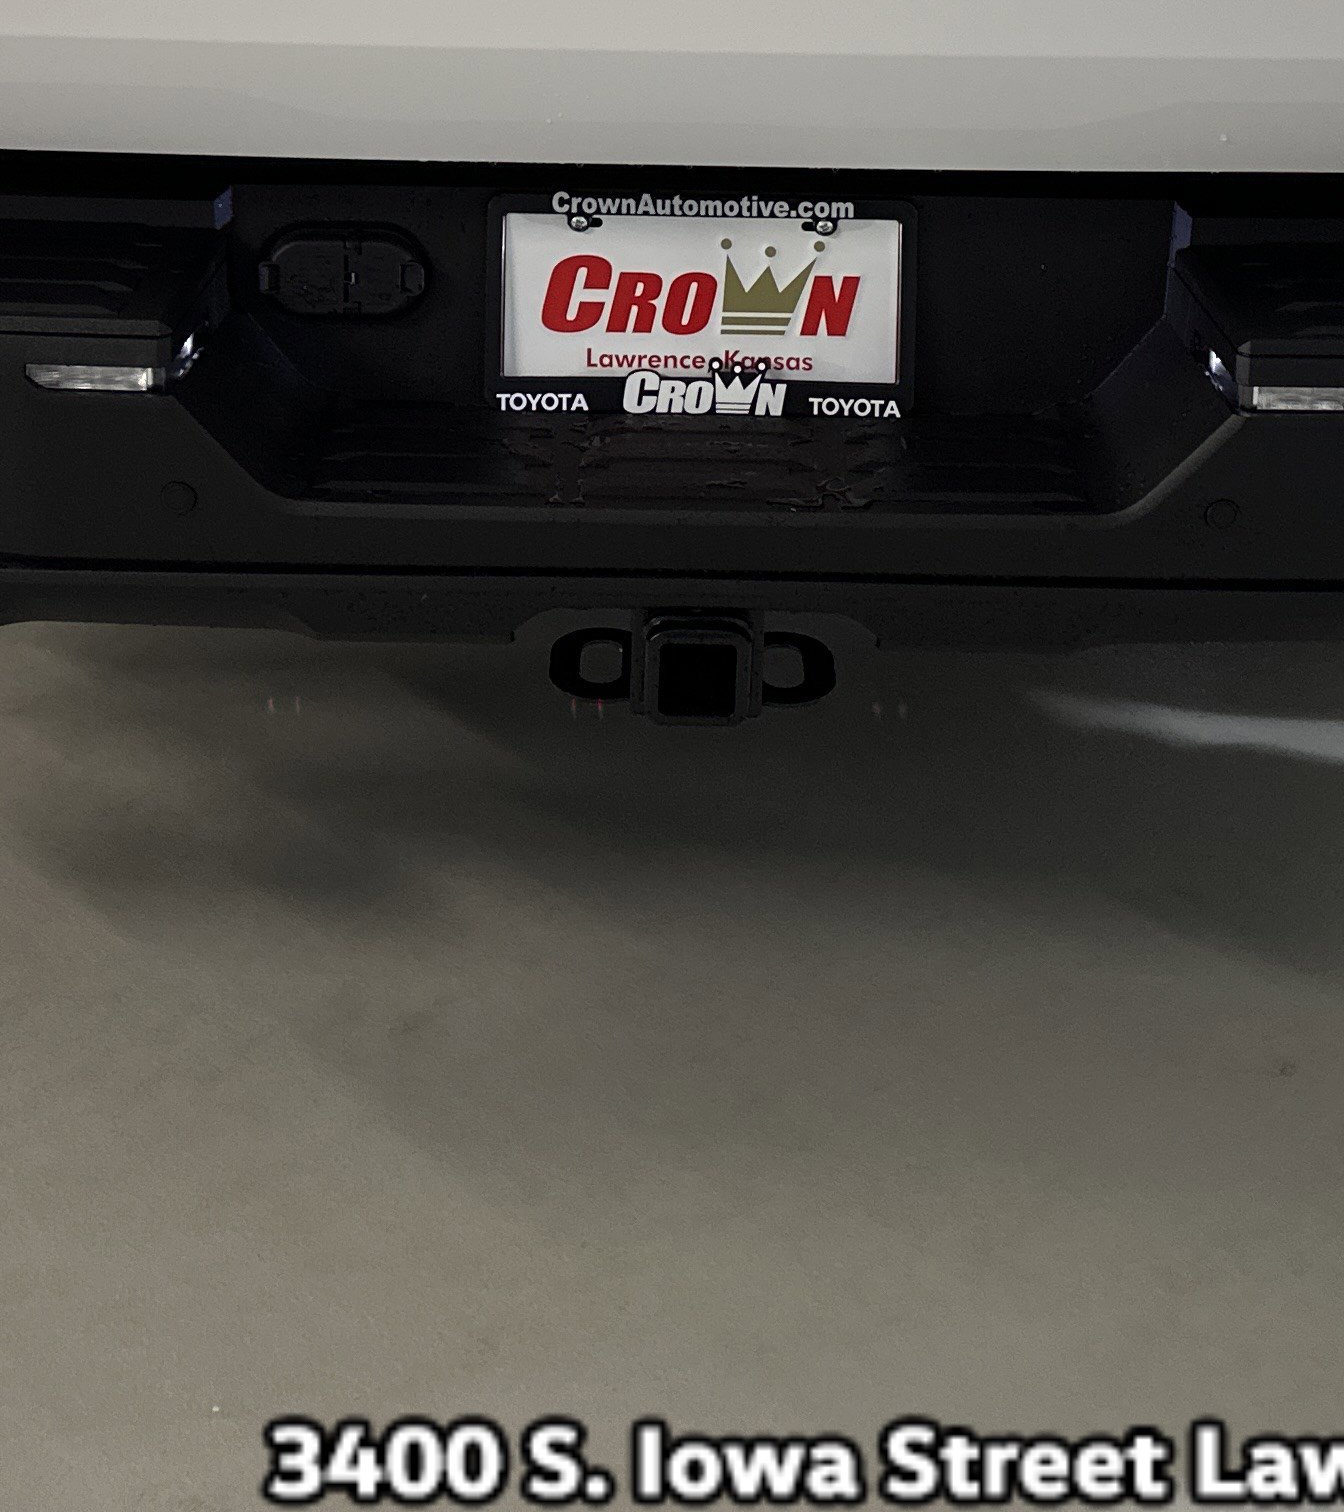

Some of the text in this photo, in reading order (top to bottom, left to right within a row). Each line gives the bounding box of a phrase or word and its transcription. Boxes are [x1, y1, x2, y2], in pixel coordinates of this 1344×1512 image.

[551, 191, 855, 219] CrownAutomotive.com
[496, 393, 589, 412] TOYOTA
[808, 397, 902, 419] TOYOTA
